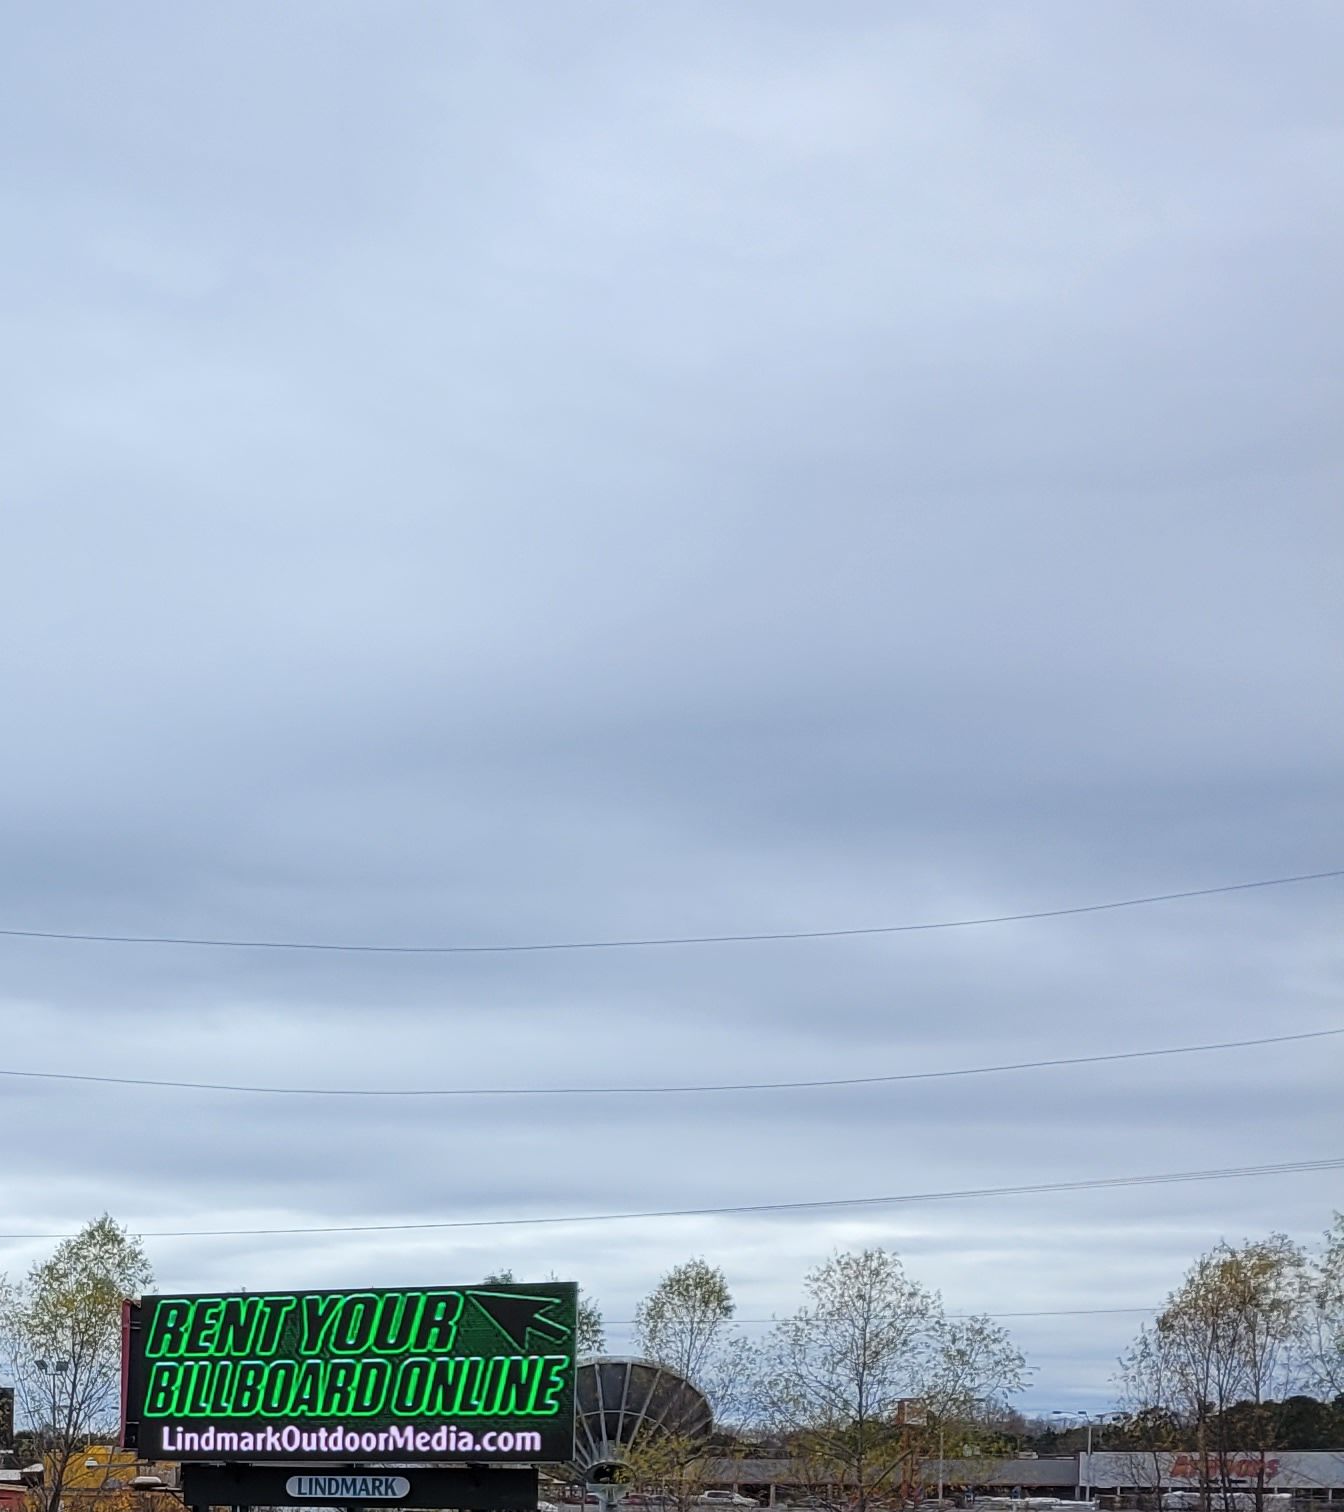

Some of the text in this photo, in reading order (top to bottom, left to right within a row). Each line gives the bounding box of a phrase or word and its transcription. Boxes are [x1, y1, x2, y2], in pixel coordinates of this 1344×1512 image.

[145, 1291, 464, 1358] RENT YOUR
[143, 1354, 570, 1417] BILLBOARD ONLINE
[162, 1425, 542, 1452] LindmarkOutdoorMedia.com
[297, 1477, 398, 1497] LINDMARK
